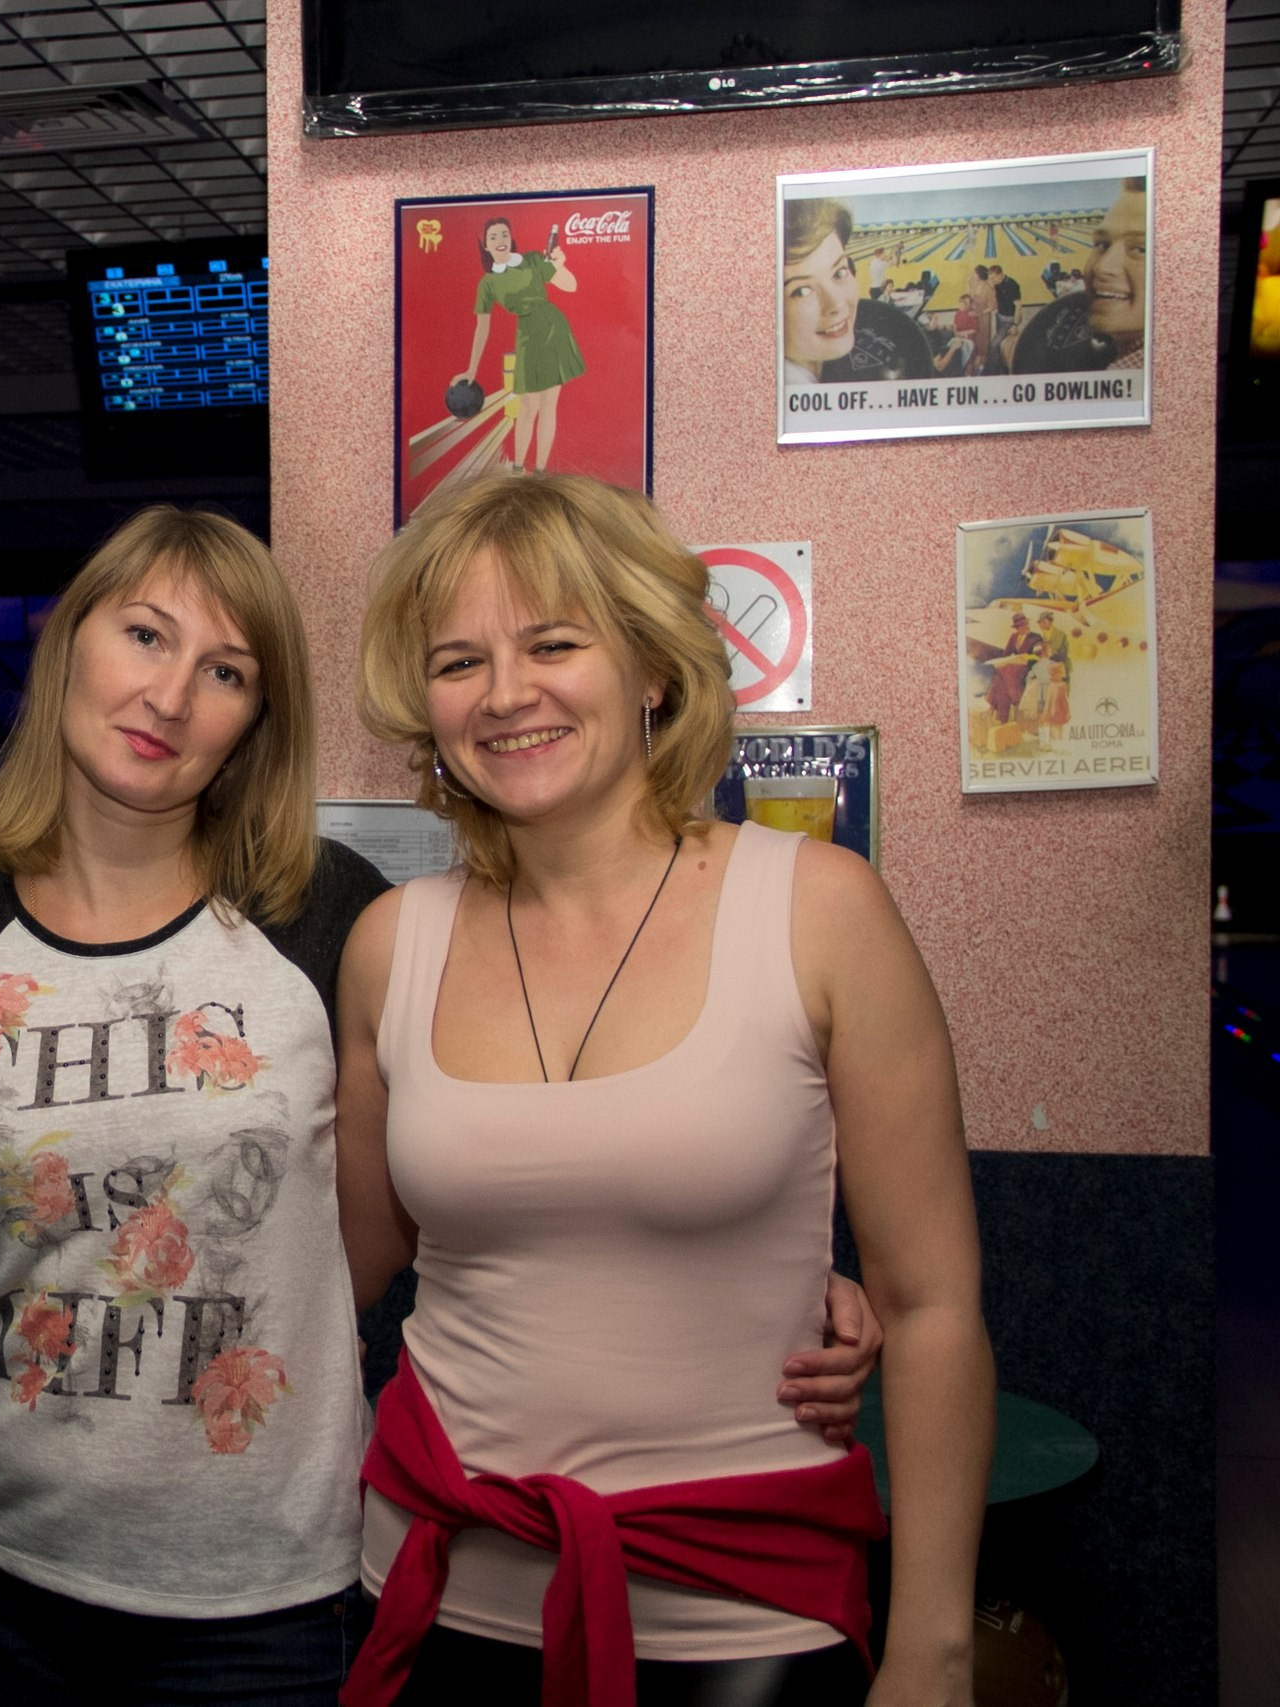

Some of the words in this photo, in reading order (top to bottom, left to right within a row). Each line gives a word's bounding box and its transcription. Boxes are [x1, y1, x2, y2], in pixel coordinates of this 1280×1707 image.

[565, 210, 632, 236] Coca-Cola
[566, 236, 593, 245] ENJOY
[595, 235, 612, 243] THE
[613, 234, 631, 242] FUN
[789, 392, 832, 412] COOL
[897, 387, 938, 407] HAVE
[1012, 383, 1036, 403] GO
[1044, 379, 1132, 401] BOWLING!
[1091, 740, 1124, 749] ROMA
[969, 759, 1065, 779] SERVIZI
[1074, 756, 1151, 774] AEREI
